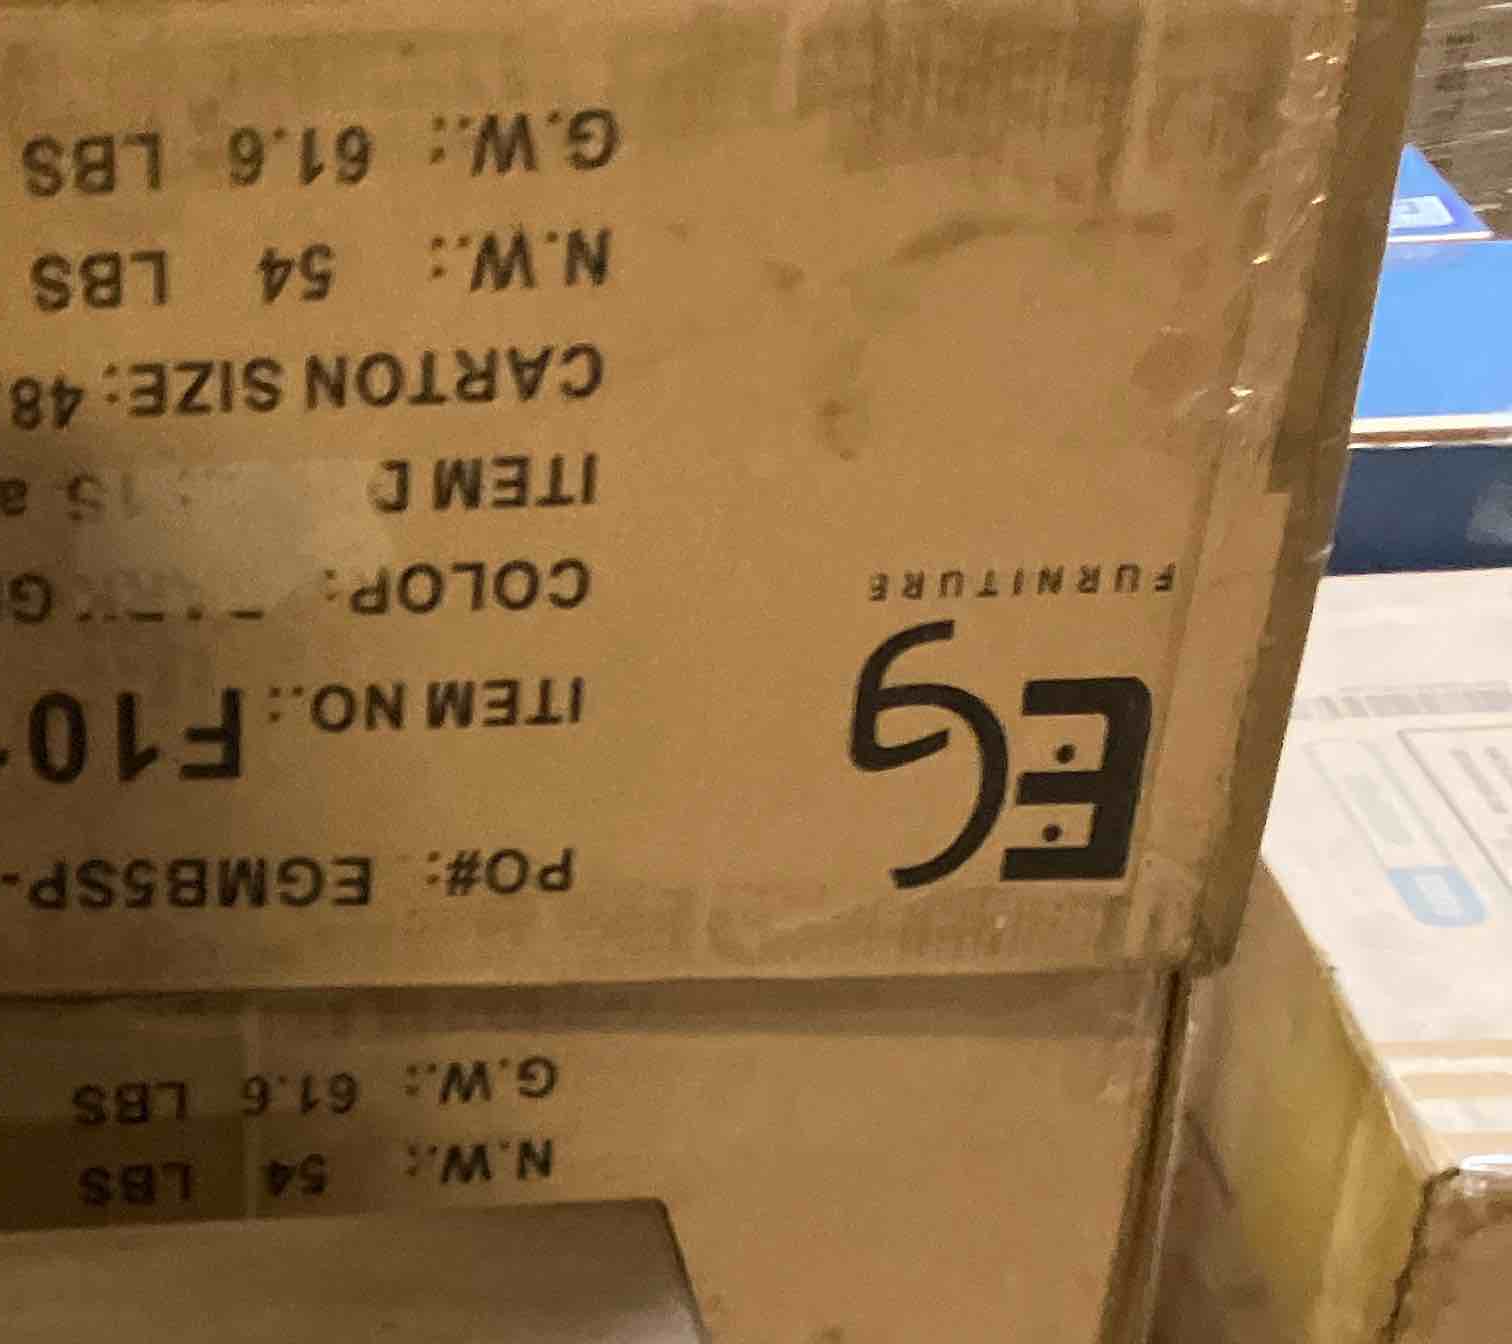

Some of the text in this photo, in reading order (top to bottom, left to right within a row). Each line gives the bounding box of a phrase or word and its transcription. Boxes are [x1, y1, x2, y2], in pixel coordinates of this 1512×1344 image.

[21, 108, 619, 198] G.W.: 61.6 LBS
[29, 225, 611, 313] N.W.: 54 LBS
[102, 356, 283, 418] SIZE:
[305, 342, 604, 410] CARTON
[432, 452, 598, 511] ITEM
[867, 561, 1176, 601] FURNITURE
[267, 681, 406, 735] NO.:
[425, 675, 586, 730] ITEM
[424, 847, 576, 899] PO#:
[72, 1056, 559, 1127] G.W.: 61.6 LBS
[79, 1137, 553, 1206] N.W.: 54 LBS
